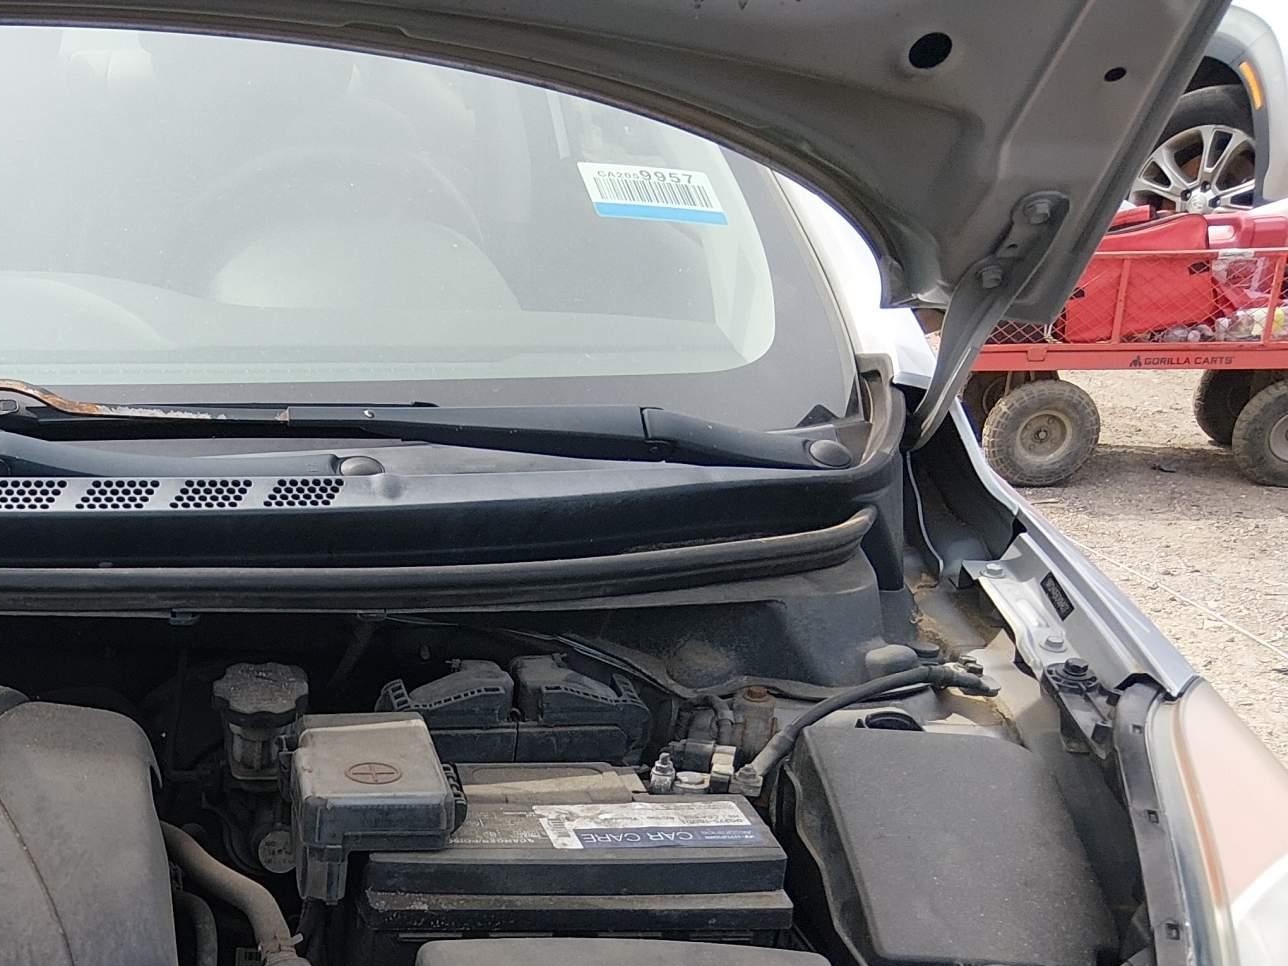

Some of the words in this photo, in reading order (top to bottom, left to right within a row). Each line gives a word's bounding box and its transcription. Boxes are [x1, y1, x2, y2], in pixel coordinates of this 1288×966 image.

[1144, 357, 1191, 366] GORILLA
[1194, 356, 1234, 365] CARTS
[581, 832, 642, 844] CARE
[646, 831, 694, 842] CAR
